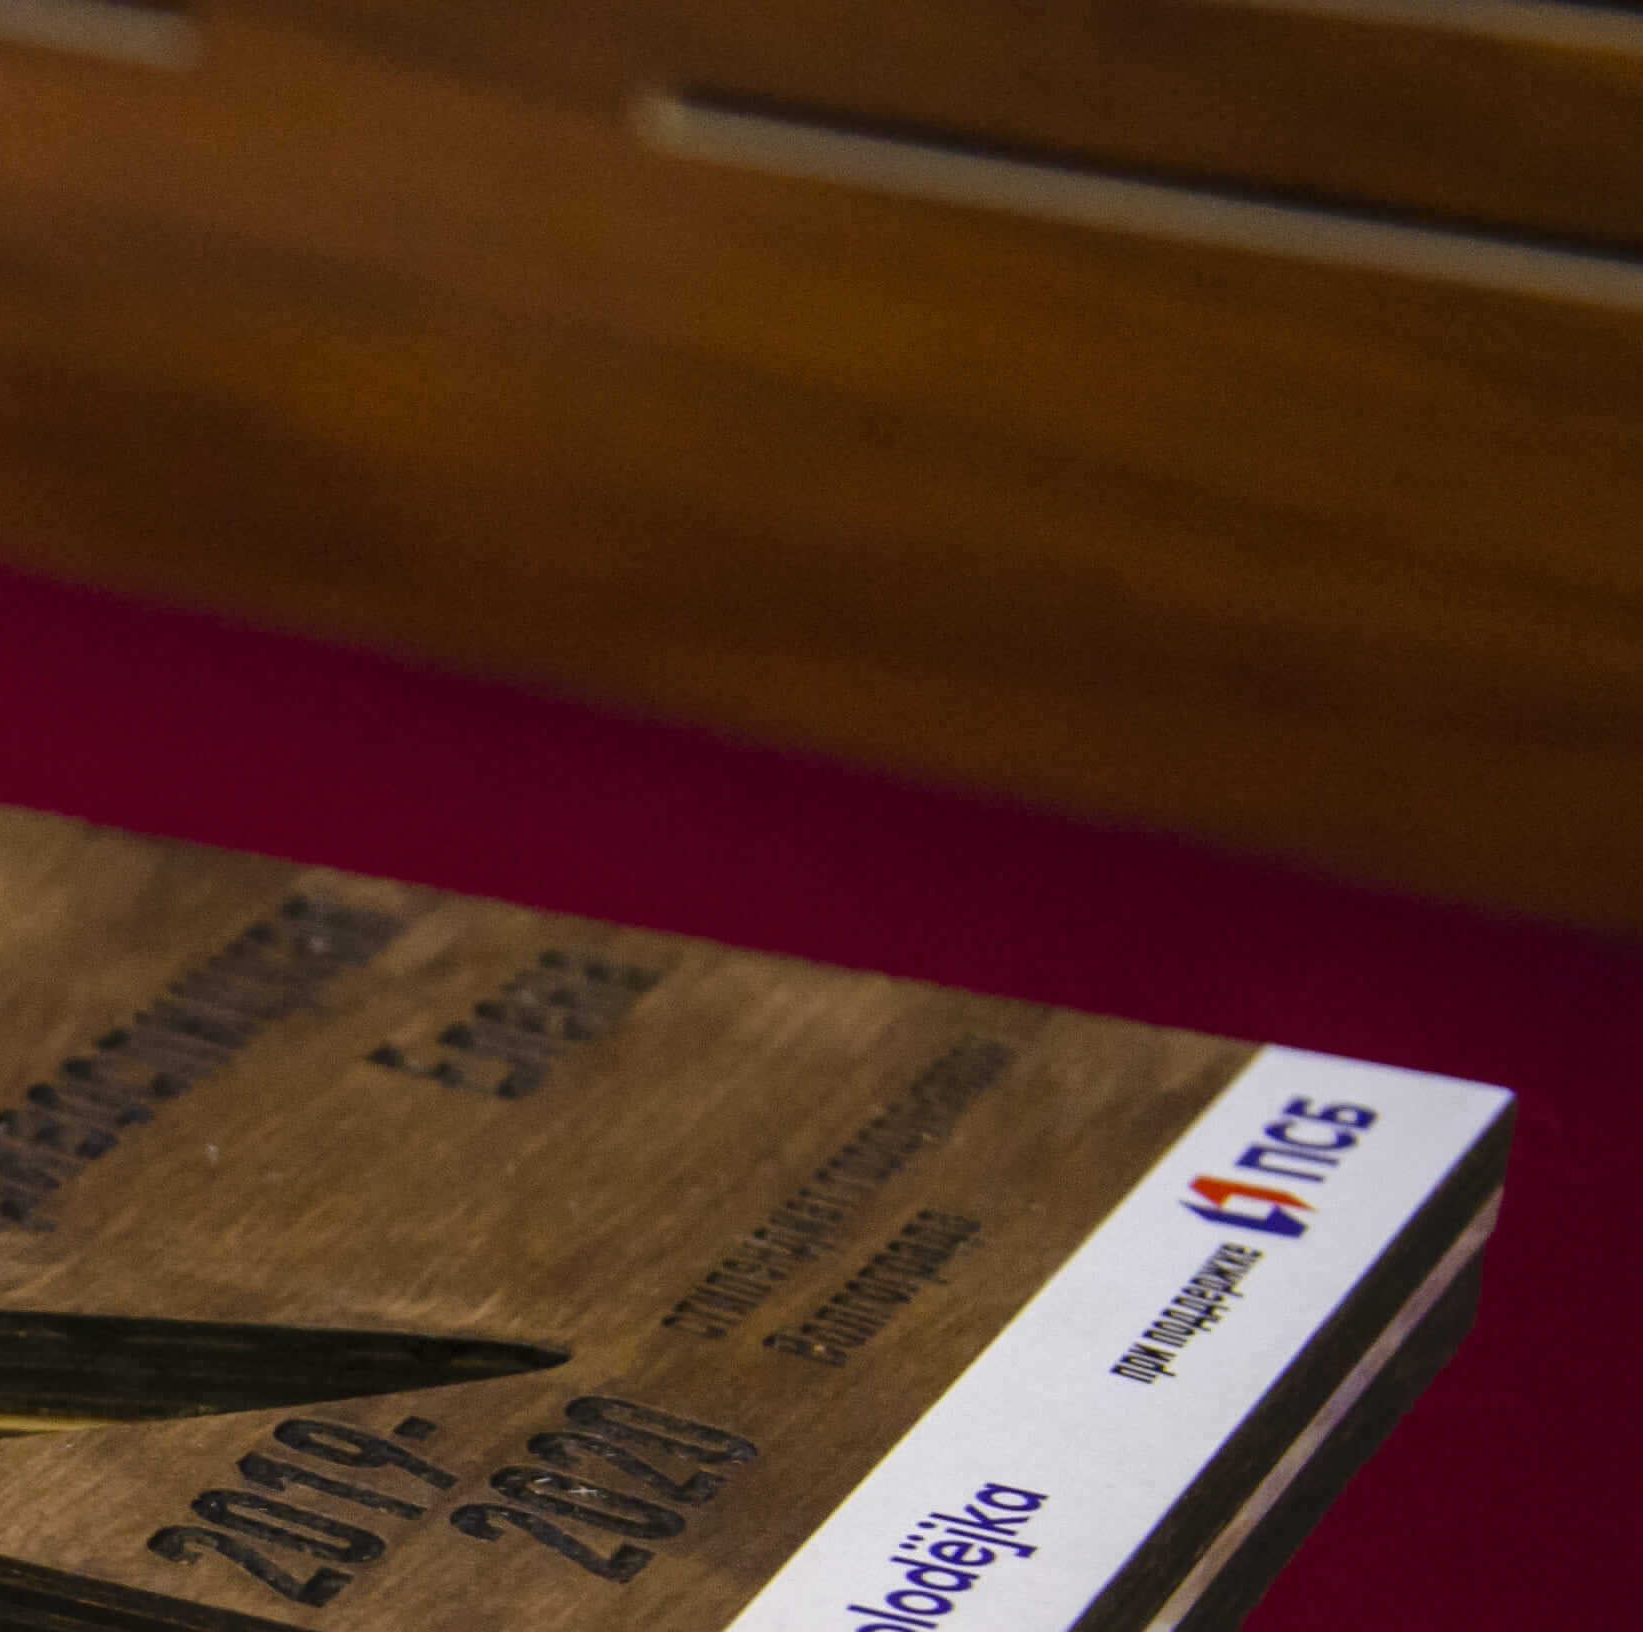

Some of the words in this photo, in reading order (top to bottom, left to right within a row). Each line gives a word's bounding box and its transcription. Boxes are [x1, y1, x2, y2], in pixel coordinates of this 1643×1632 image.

[1233, 1096, 1379, 1183] ПСБ
[1141, 1241, 1265, 1349] поддержке
[1109, 1342, 1177, 1385] при
[146, 1416, 458, 1608] 2019-
[450, 1394, 758, 1584] 2020
